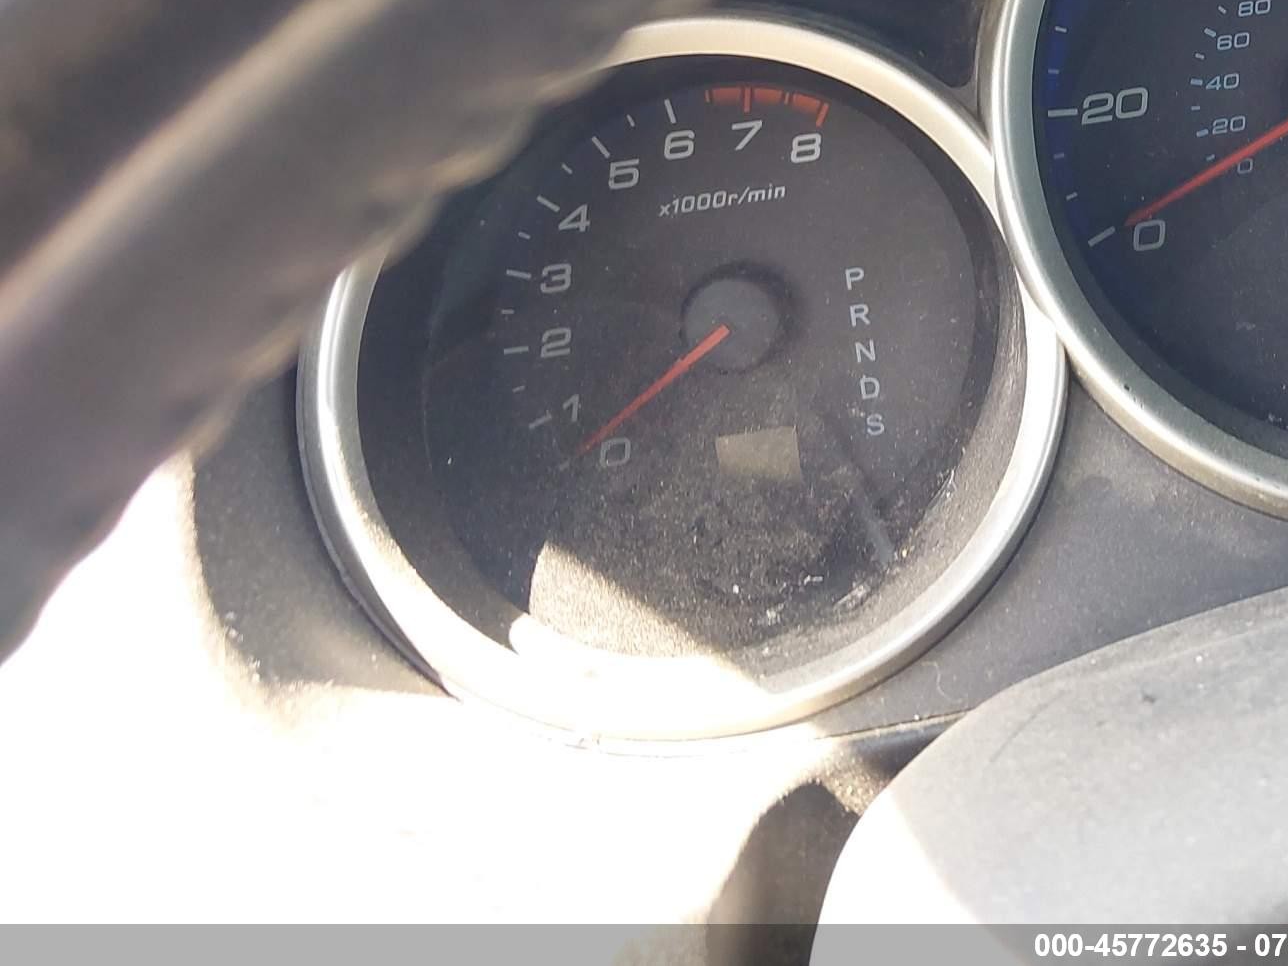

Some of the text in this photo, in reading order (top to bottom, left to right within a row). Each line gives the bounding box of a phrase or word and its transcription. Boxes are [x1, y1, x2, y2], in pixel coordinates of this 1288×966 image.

[1216, 31, 1250, 50] 60
[1205, 71, 1240, 90] 40
[1081, 86, 1149, 124] 20
[730, 121, 763, 151] 7
[1211, 114, 1246, 135] 20
[663, 130, 695, 160] 6
[789, 133, 823, 163] 8
[607, 158, 640, 189] 5
[1237, 158, 1253, 174] 0
[658, 183, 786, 217] x1000r/min
[558, 205, 590, 232] 4
[1132, 219, 1165, 251] 0
[539, 263, 572, 294] 3
[845, 267, 864, 291] P
[850, 304, 870, 328] R
[539, 328, 572, 358] 2
[855, 340, 876, 363] N
[860, 377, 880, 400] D
[562, 394, 581, 423] 1
[866, 414, 886, 437] S
[600, 438, 631, 467] 0
